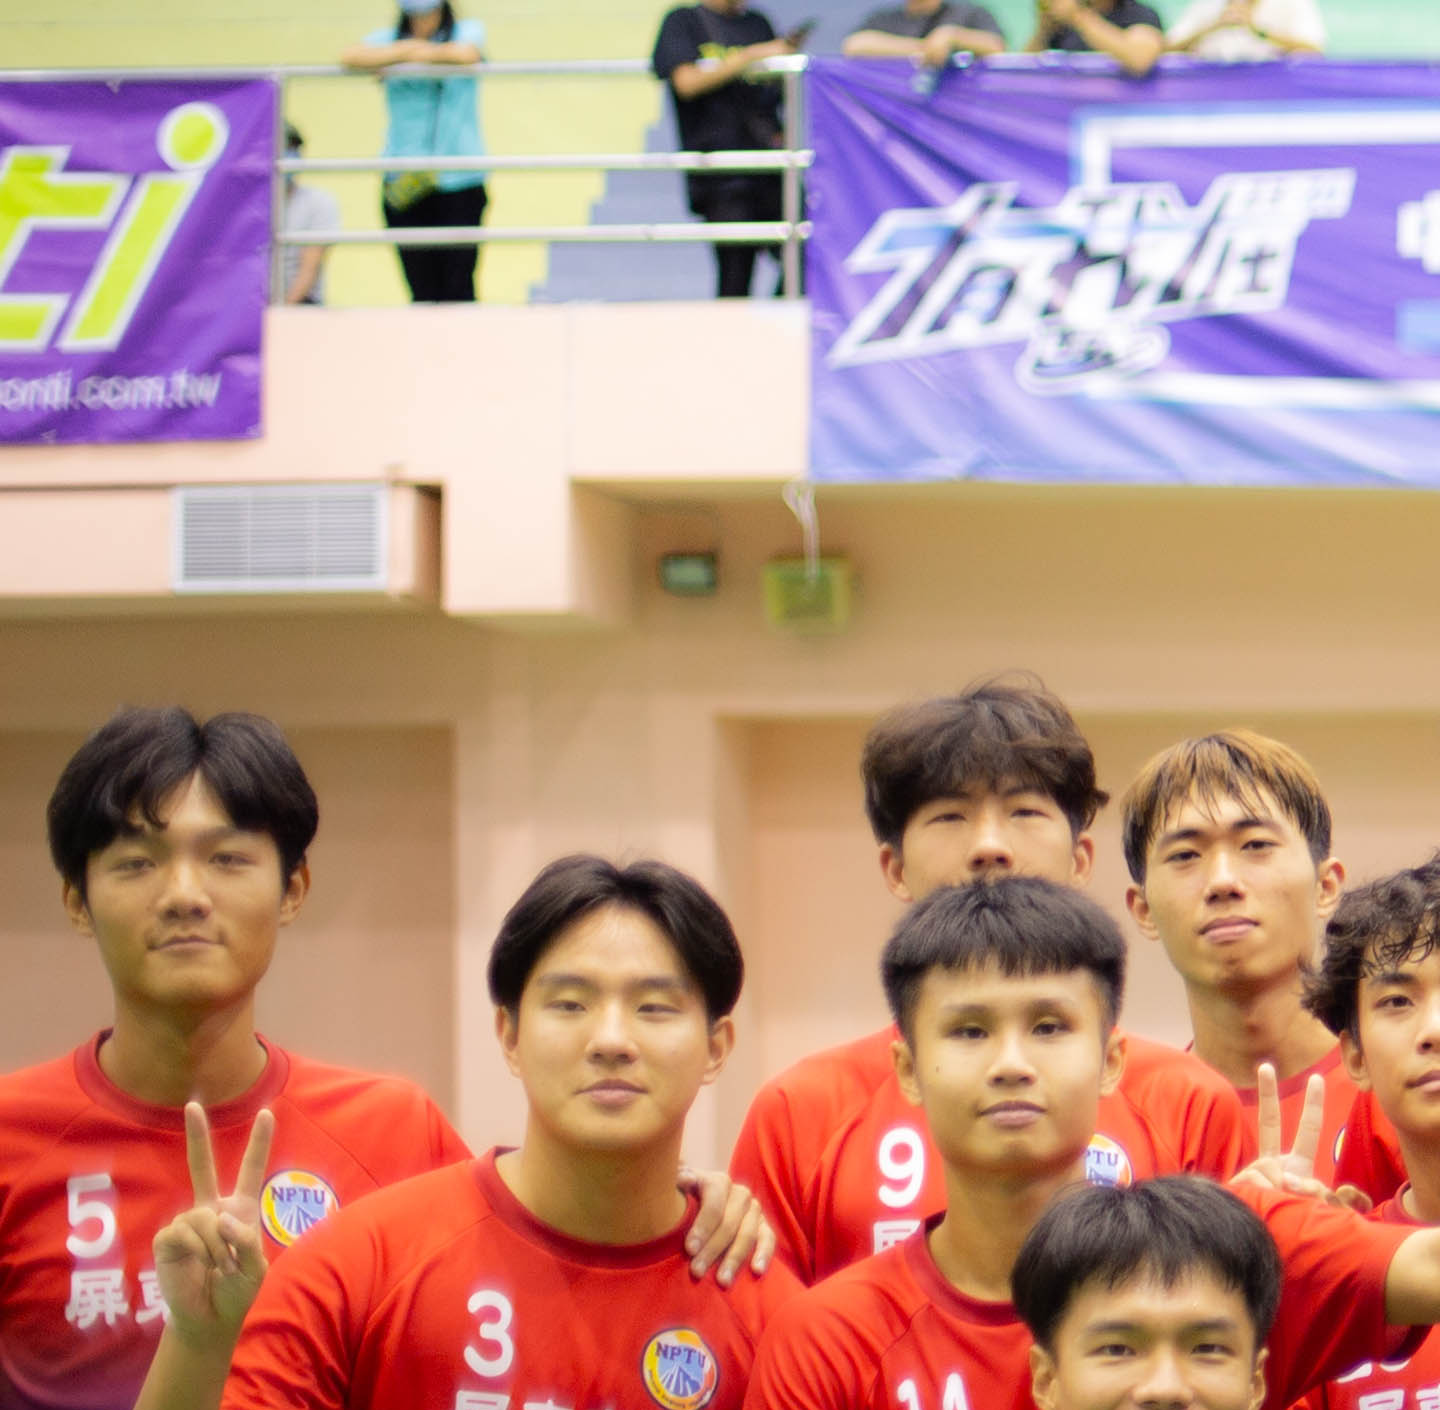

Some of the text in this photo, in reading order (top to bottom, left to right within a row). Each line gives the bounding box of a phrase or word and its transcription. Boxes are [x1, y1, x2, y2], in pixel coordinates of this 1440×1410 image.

[271, 1186, 326, 1204] NPTU
[877, 1126, 925, 1208] 9
[65, 1172, 117, 1258] 5
[463, 1289, 515, 1378] 3
[655, 1341, 706, 1369] NPTU
